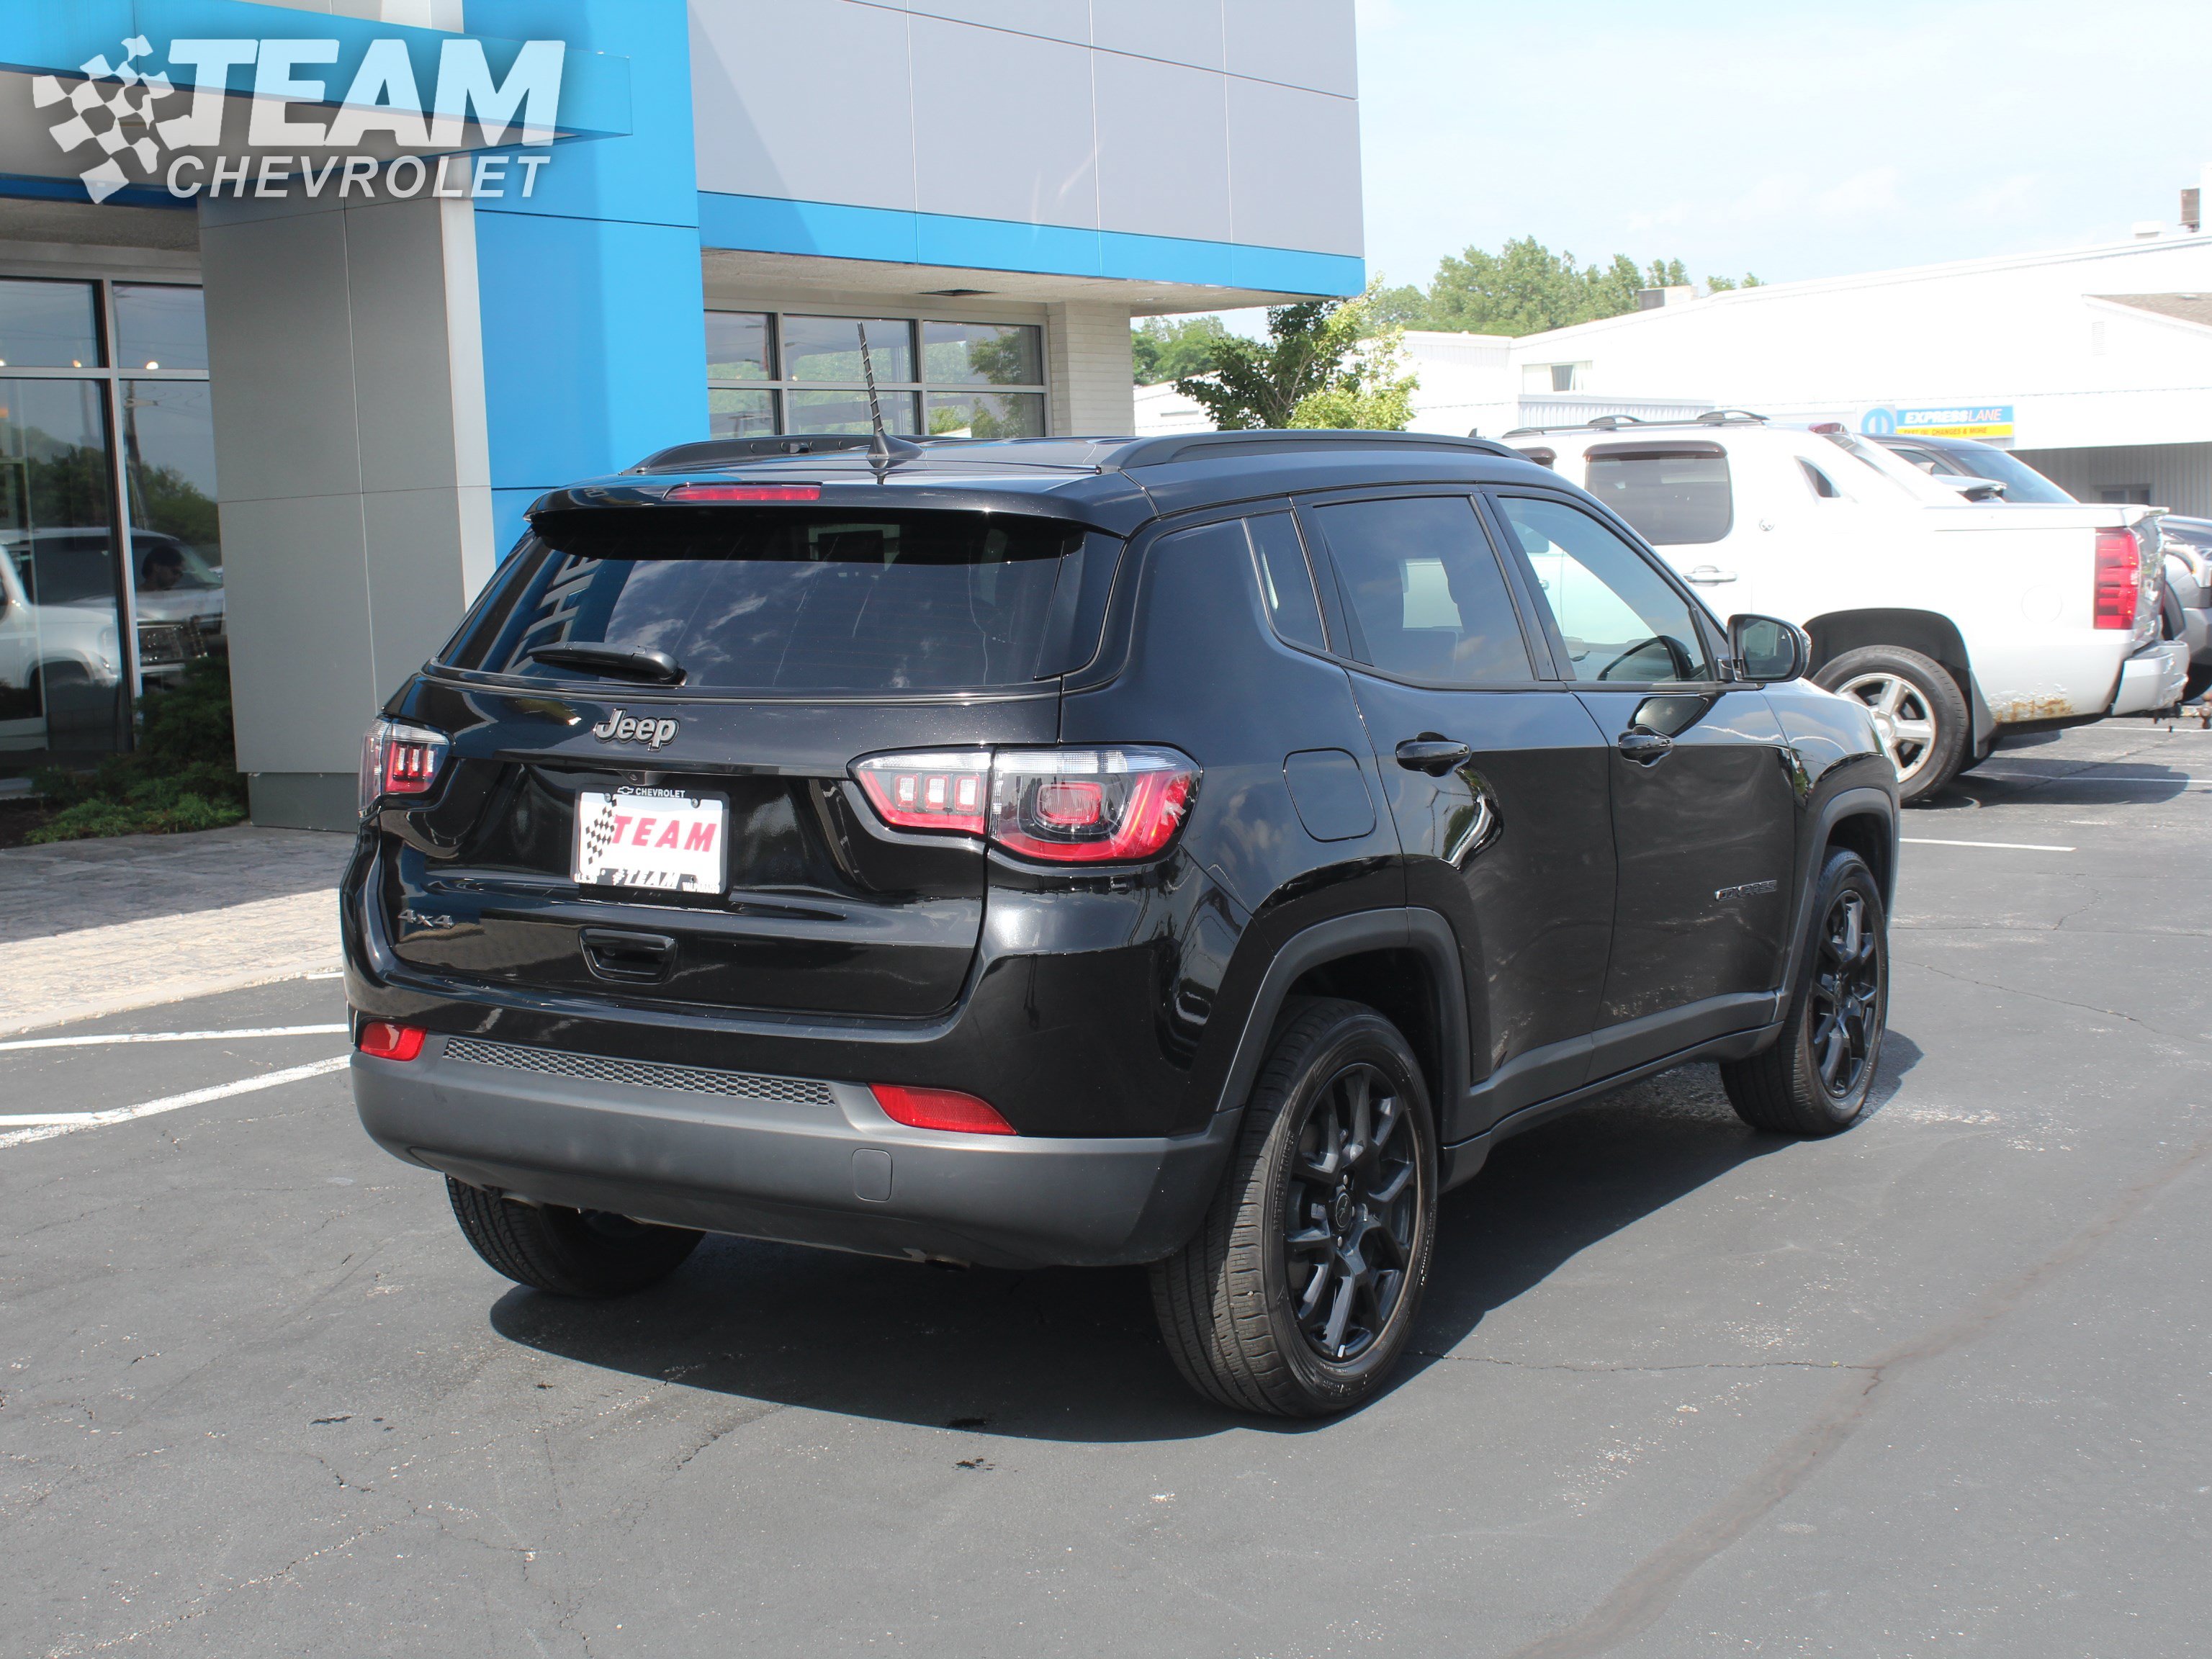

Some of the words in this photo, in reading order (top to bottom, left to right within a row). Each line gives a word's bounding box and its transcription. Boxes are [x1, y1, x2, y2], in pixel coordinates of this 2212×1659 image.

[1932, 428, 1961, 436] CHANGES
[595, 708, 680, 752] Jeep
[636, 788, 685, 798] CHEVROLET
[612, 814, 717, 853] TEAM
[624, 870, 681, 888] TEAM
[1714, 880, 1777, 901] COMPASS
